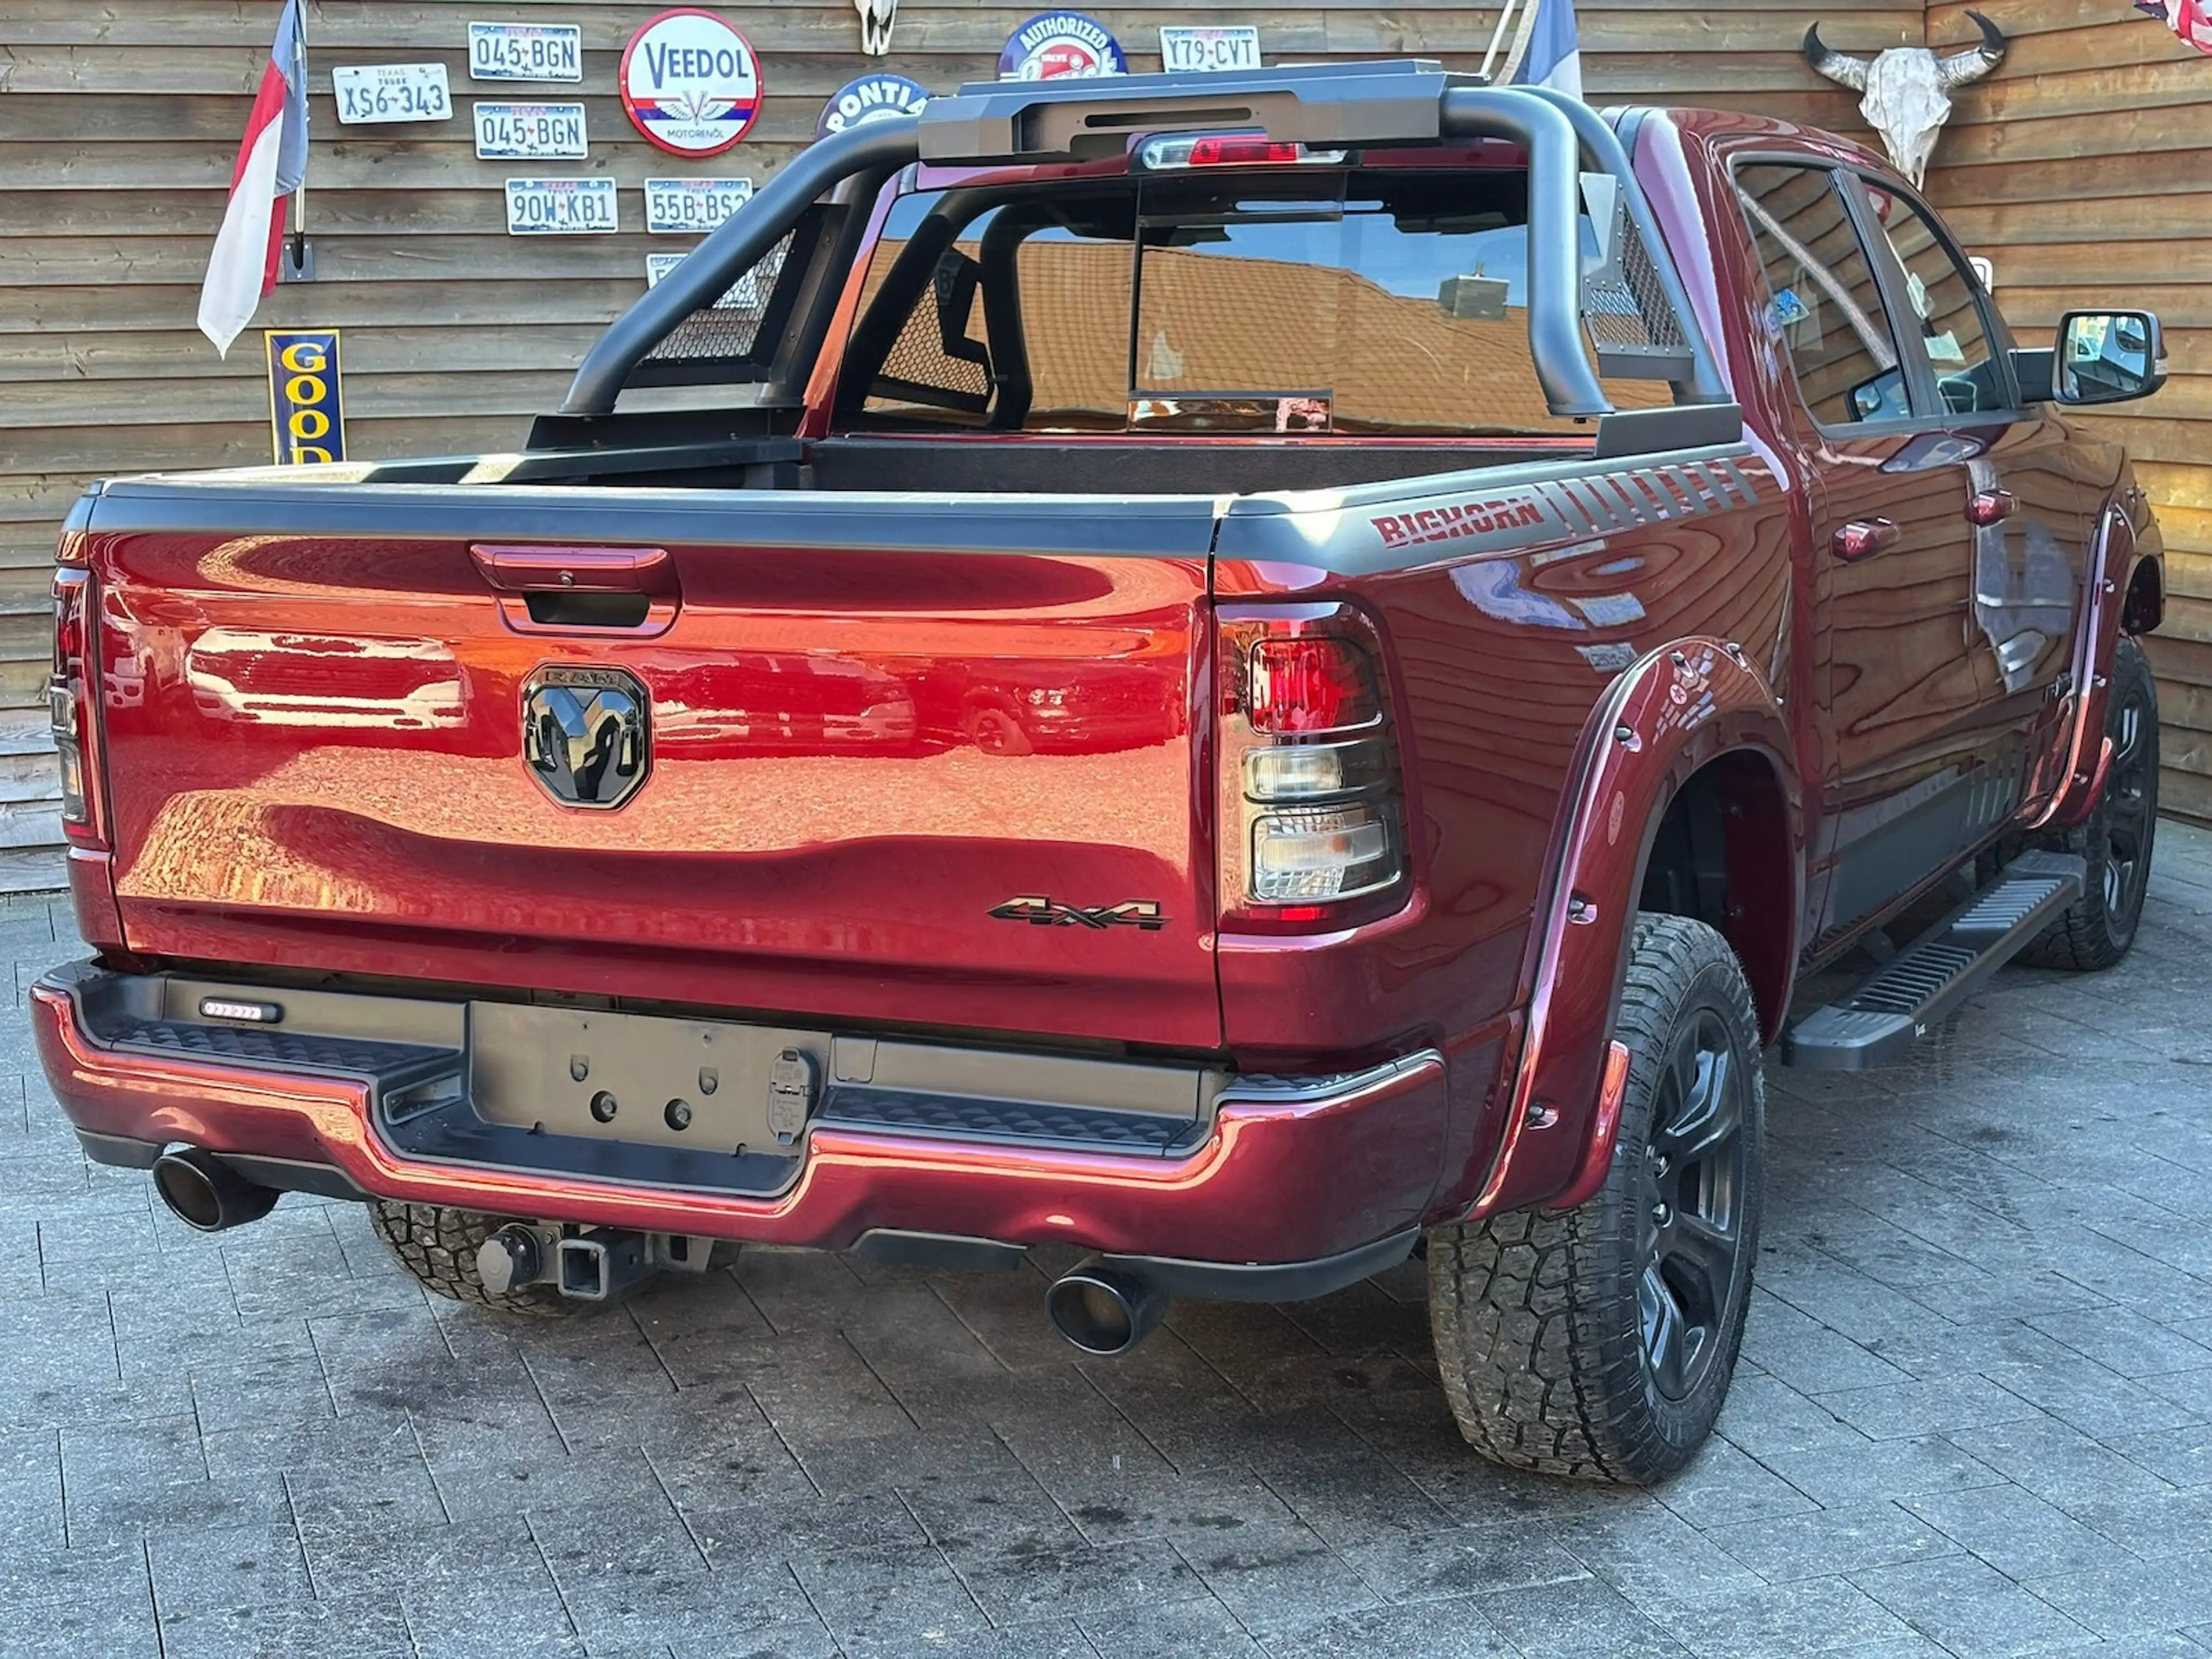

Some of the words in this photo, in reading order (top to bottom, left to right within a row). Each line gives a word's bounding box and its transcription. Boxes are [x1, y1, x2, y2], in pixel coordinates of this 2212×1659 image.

[1019, 16, 1108, 51] AUTHORIZED
[645, 43, 748, 89] VEEDOL
[281, 343, 333, 465] GOOD
[1370, 496, 1545, 548] BIGHORN
